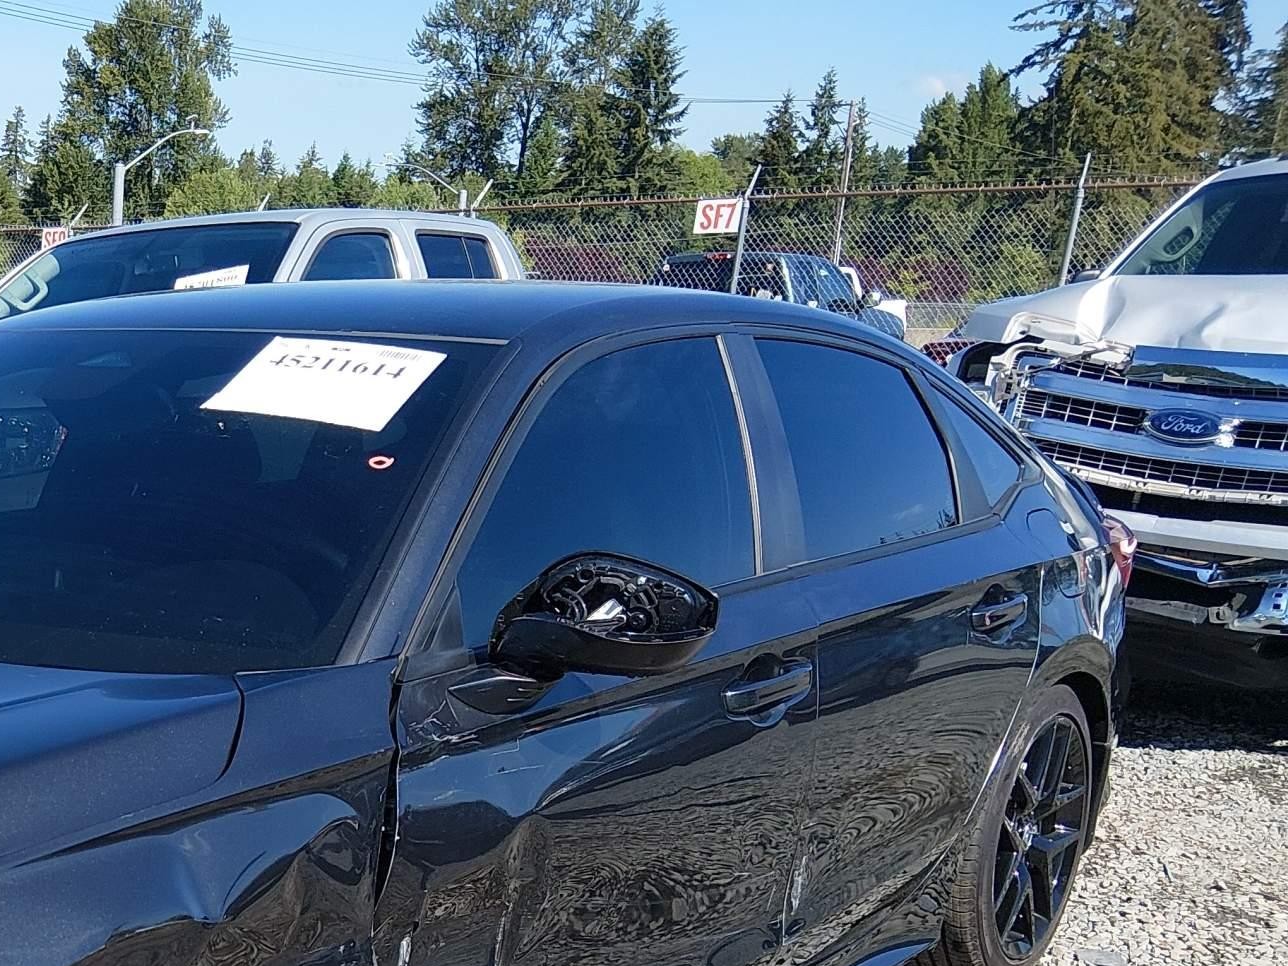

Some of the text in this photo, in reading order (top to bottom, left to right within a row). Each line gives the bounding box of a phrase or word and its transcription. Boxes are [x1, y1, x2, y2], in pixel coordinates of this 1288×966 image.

[700, 203, 737, 230] SF7
[269, 353, 407, 379] 45211614
[1161, 414, 1208, 434] Ford
